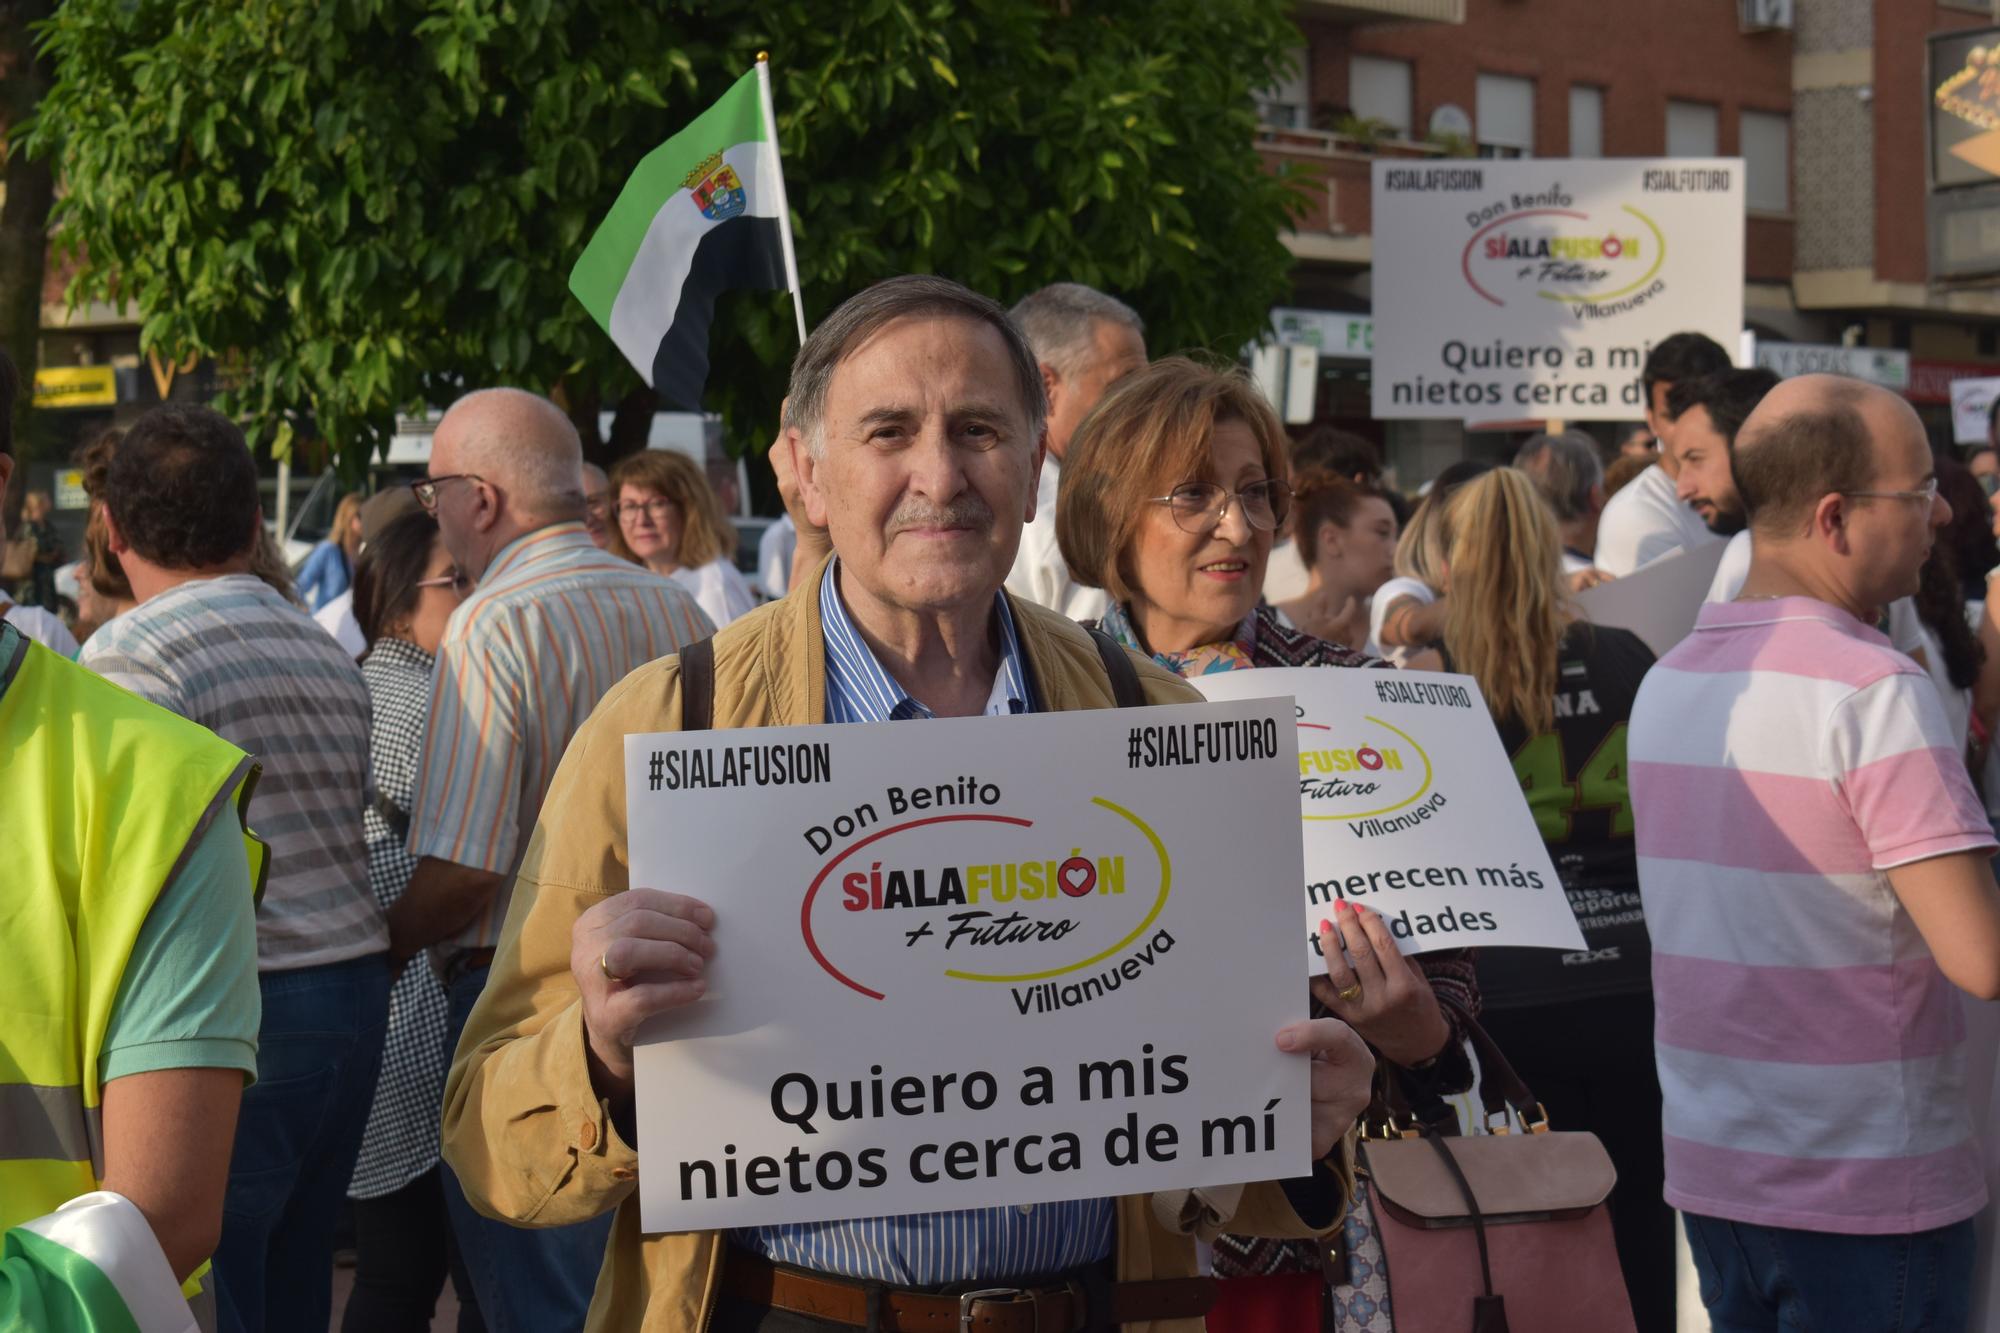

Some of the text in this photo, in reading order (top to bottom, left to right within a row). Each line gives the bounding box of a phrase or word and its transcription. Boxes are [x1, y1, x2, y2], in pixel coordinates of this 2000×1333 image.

[1385, 169, 1730, 192] #SIALAFUSION #SIALFUTURO
[1466, 183, 1572, 228] Don Benito
[1537, 261, 1609, 282] Futuro
[1572, 279, 1665, 320] Villanueva
[1441, 340, 1650, 373] Quiero a mi
[1392, 376, 1642, 404] nietos cerca d
[1375, 680, 1472, 708] #SIALFUTURO
[1553, 689, 1600, 717] NA
[649, 718, 1278, 790] #SIALAFUSION #SIALFUTURO
[1299, 742, 1403, 776] FUSIÓN
[804, 776, 1001, 856] Don Benito
[1348, 792, 1447, 839] Villanueva
[1307, 862, 1544, 906] merecen más
[944, 910, 1081, 950] Futuro
[1011, 929, 1176, 1015] Villanueva
[770, 1043, 1189, 1134] Quiero a mis
[680, 1098, 1282, 1200] nietos cerca de mí
